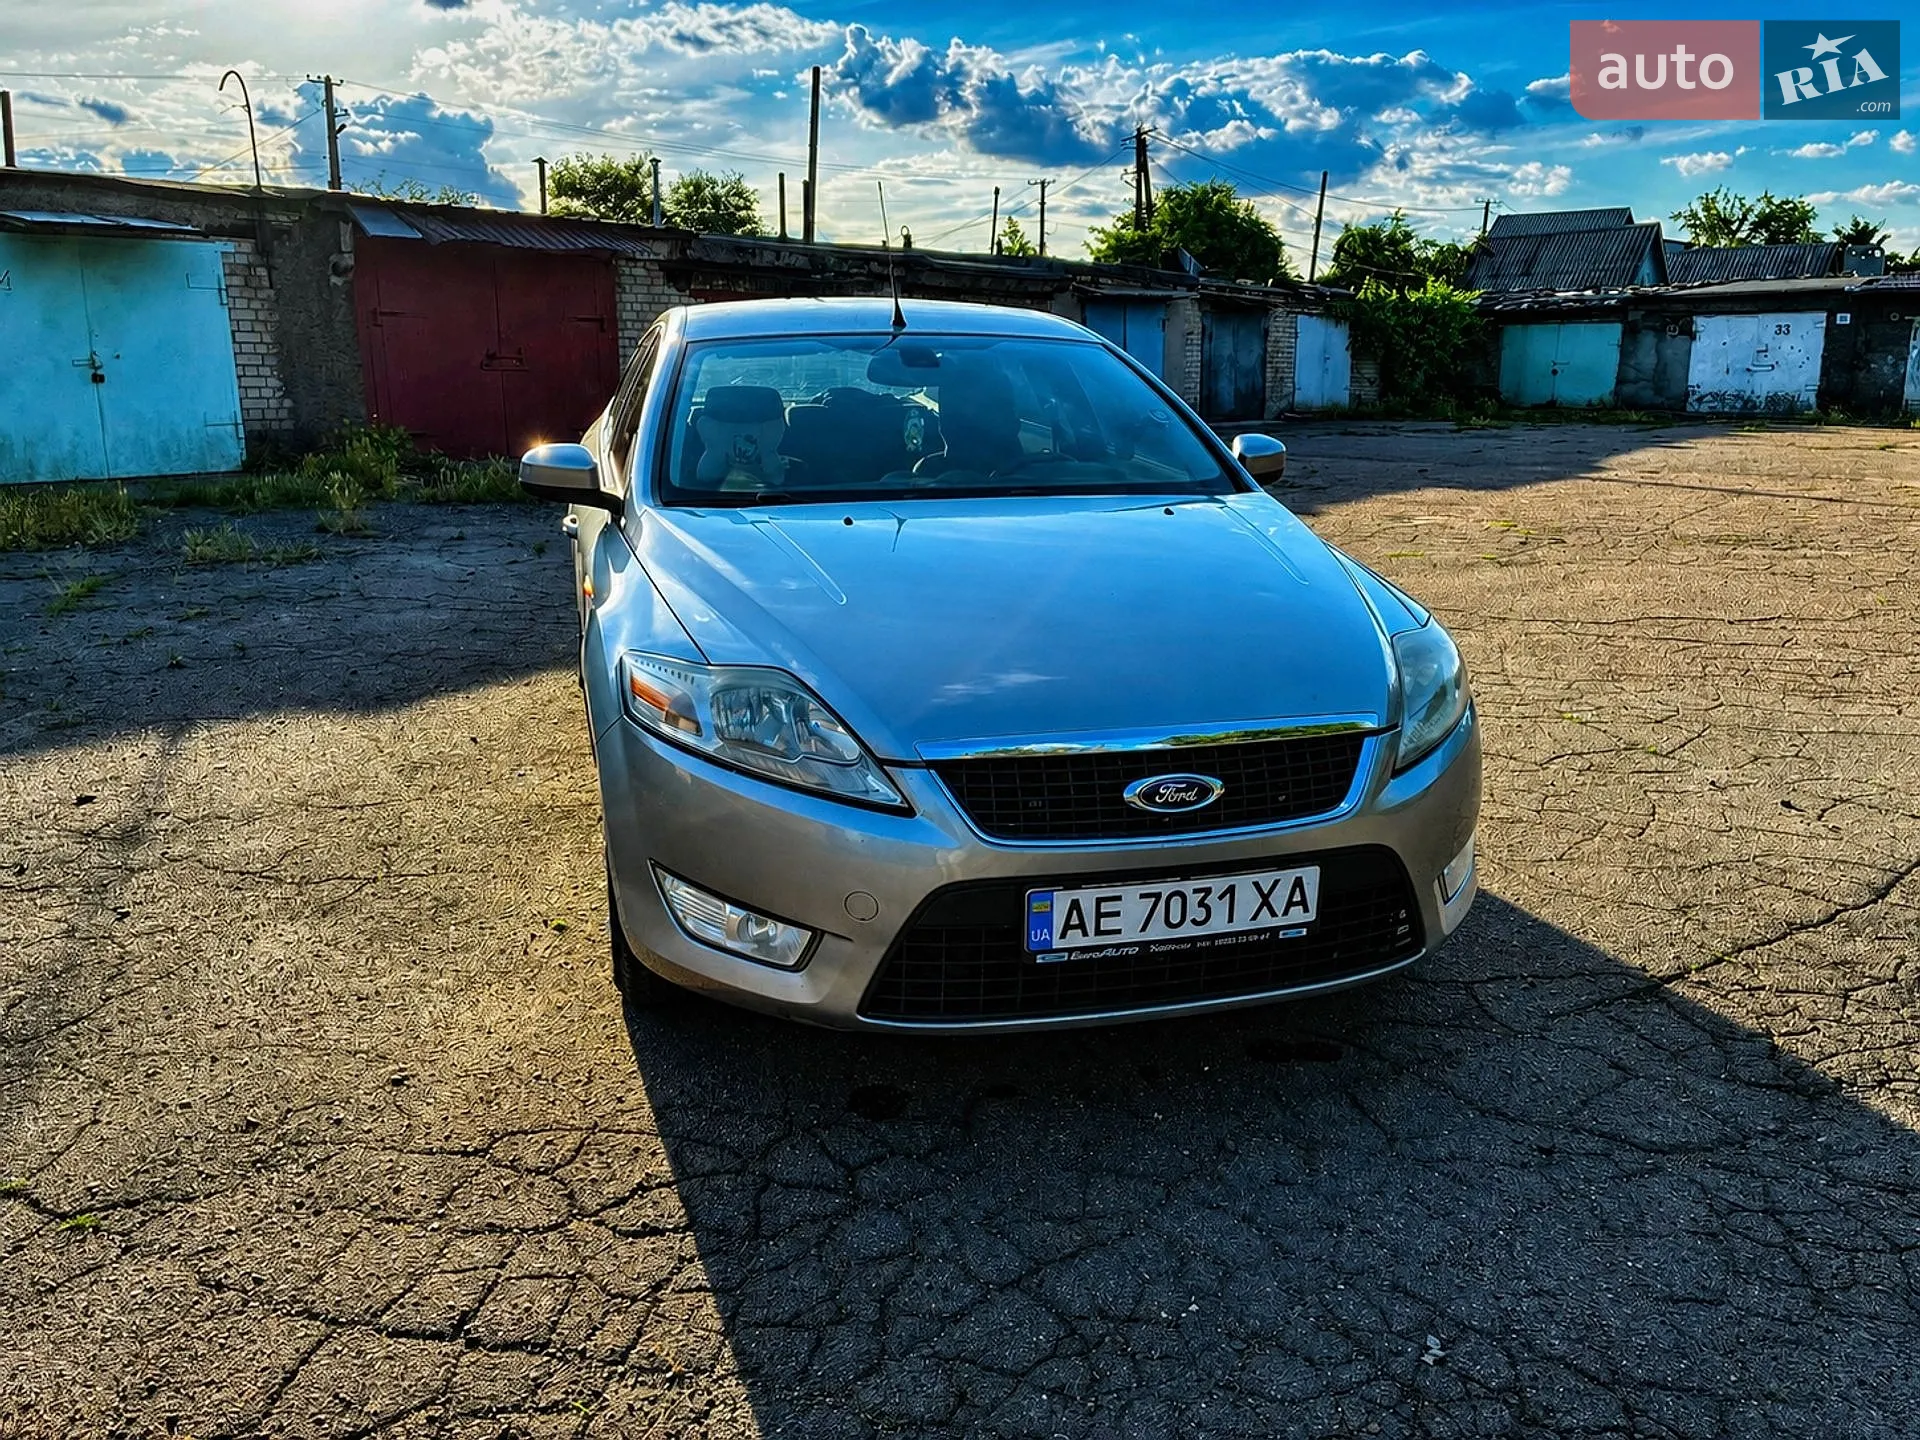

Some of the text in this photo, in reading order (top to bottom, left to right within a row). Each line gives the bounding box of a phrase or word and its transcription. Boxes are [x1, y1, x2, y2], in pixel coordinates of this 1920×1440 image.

[1774, 323, 1791, 336] 33
[1155, 783, 1199, 803] Ford
[1058, 875, 1311, 940] AE 7031 XA
[1031, 928, 1050, 942] UA
